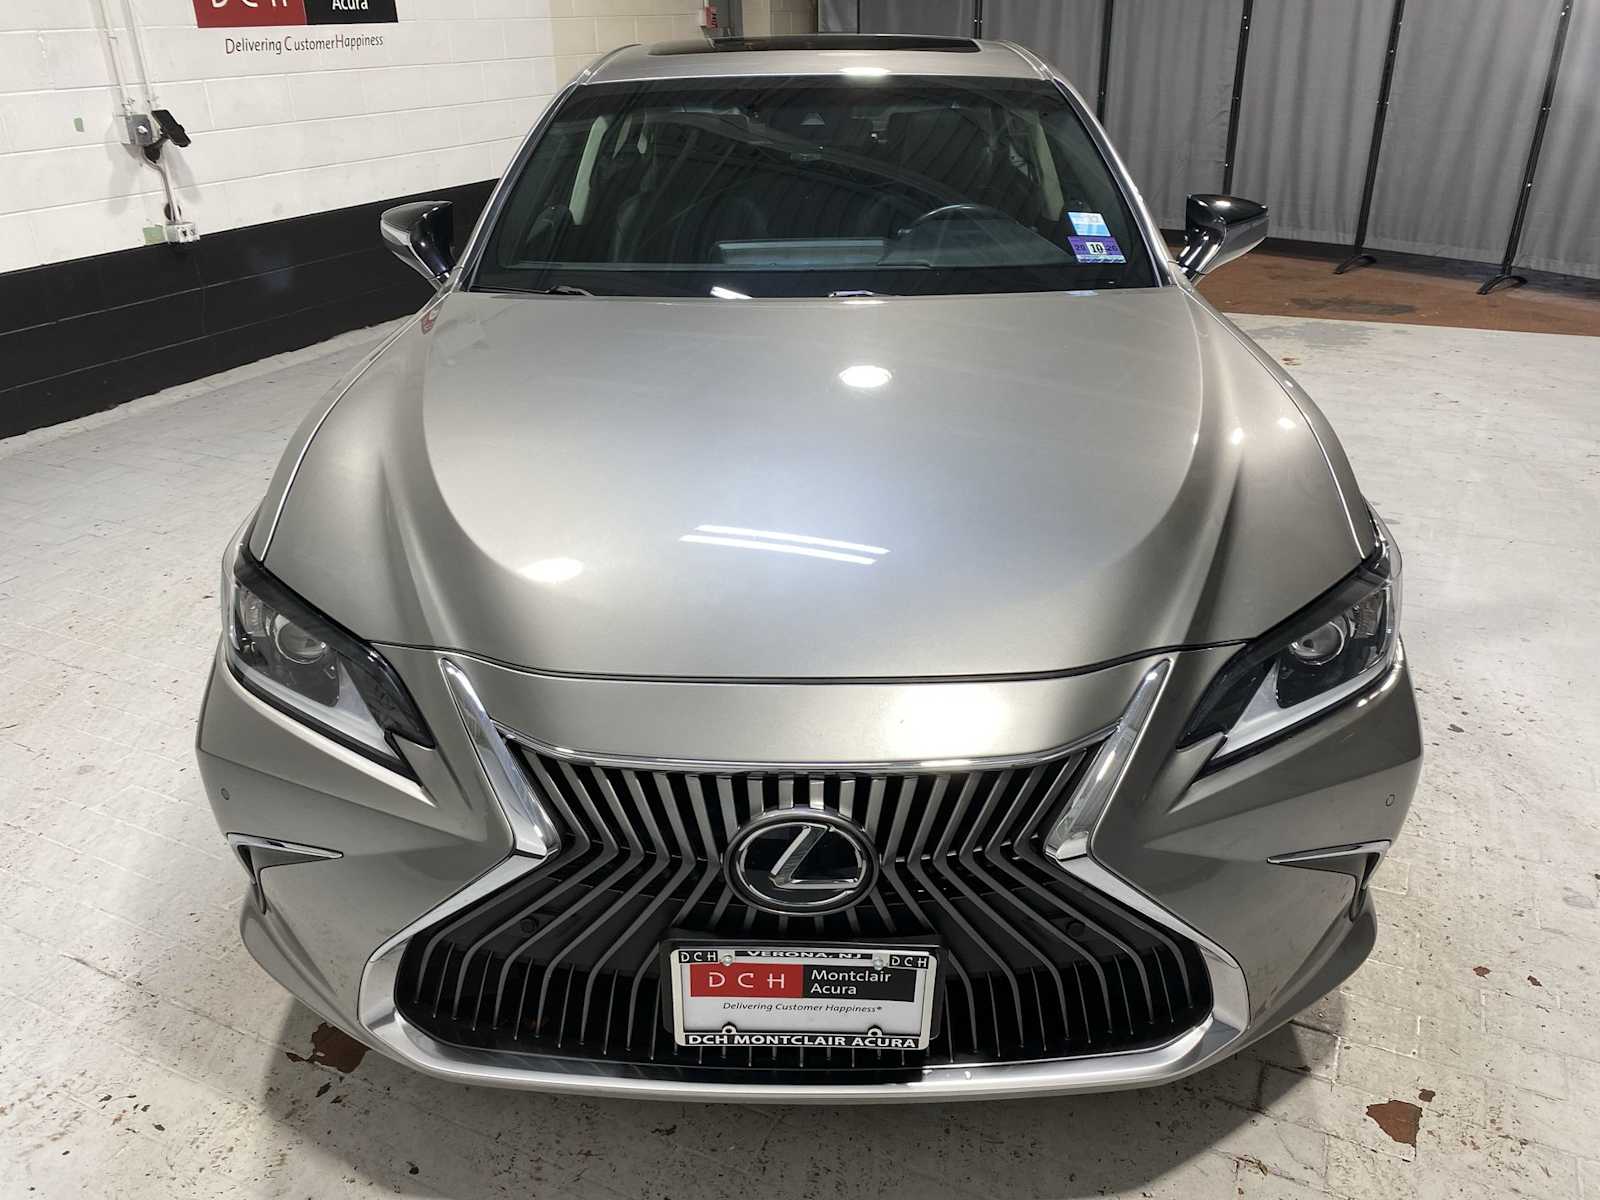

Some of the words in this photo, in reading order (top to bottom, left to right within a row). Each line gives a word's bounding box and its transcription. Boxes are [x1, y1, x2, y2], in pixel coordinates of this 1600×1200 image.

[225, 38, 282, 55] Delivering
[1090, 243, 1104, 253] 10
[811, 969, 892, 982] Montclair
[810, 983, 857, 995] Acura
[723, 1002, 773, 1012] Delivering
[775, 1003, 823, 1012] Customer
[688, 1035, 728, 1044] DCH
[733, 1035, 846, 1046] MONTCLAIR
[851, 1037, 916, 1048] ACURA
